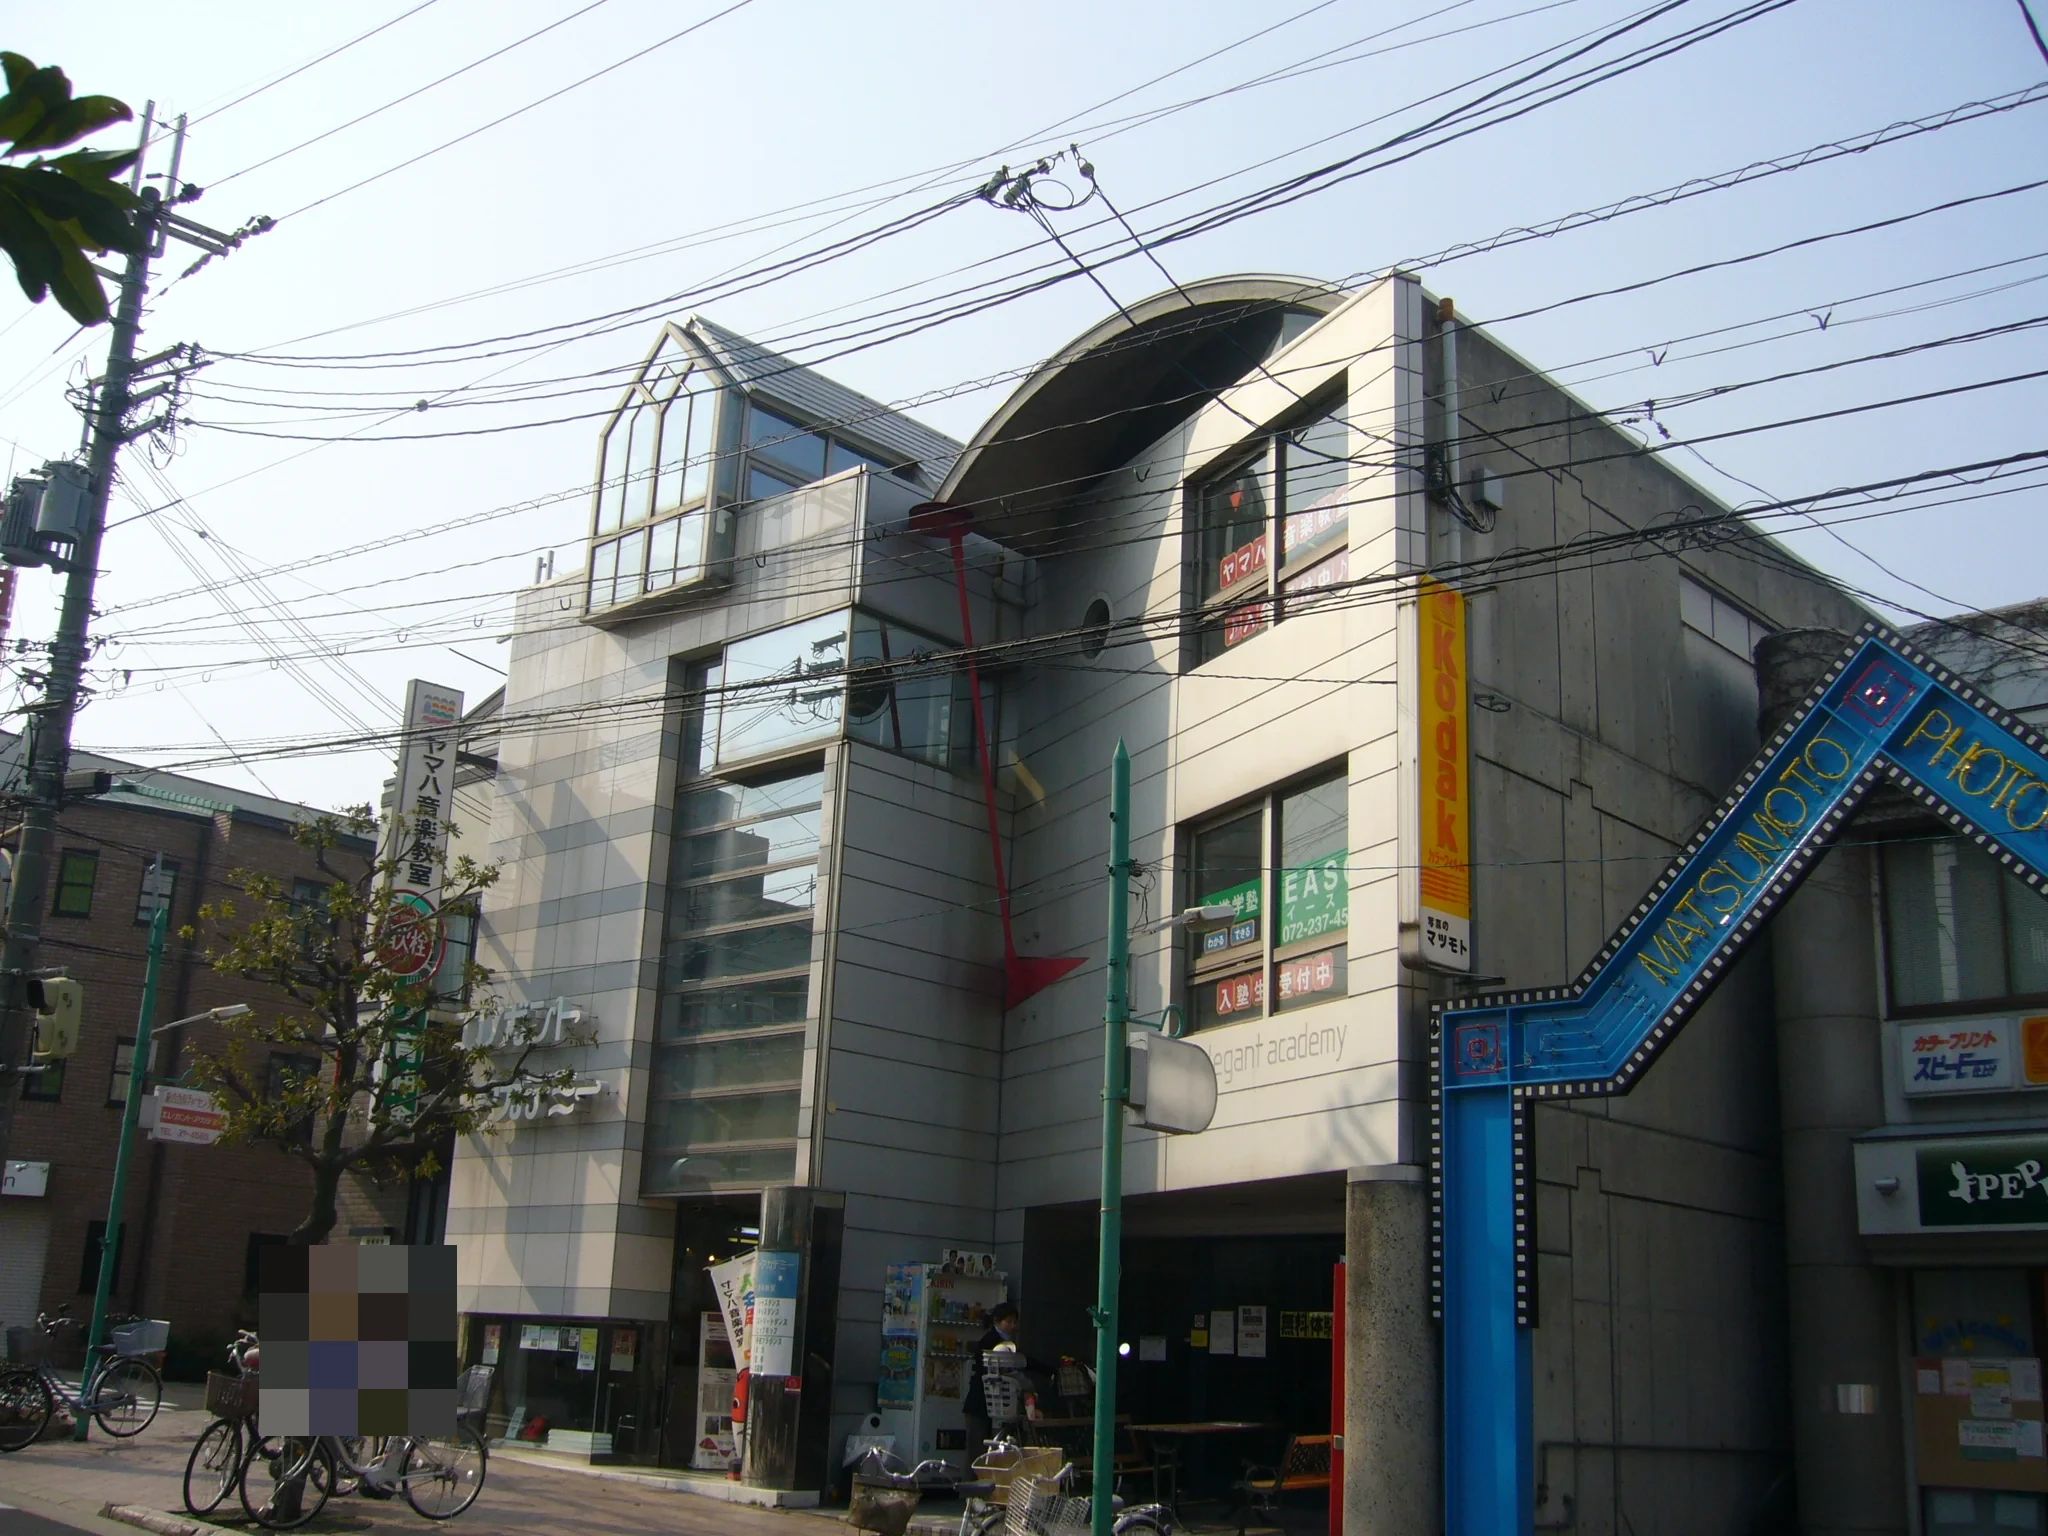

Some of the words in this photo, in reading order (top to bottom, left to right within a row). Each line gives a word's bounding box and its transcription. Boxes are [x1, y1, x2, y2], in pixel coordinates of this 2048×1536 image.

[1433, 622, 1459, 853] Kodak
[1903, 709, 2048, 832] PHOTO
[407, 735, 446, 887] ヤマハ音楽教室
[1285, 859, 1349, 904] EAS
[1636, 737, 1852, 987] MATSUMOTO
[1204, 889, 1259, 915] 学塾
[1426, 930, 1468, 955] マツモト
[1267, 1022, 1348, 1065] academy
[1911, 1030, 1997, 1052] カラープリント
